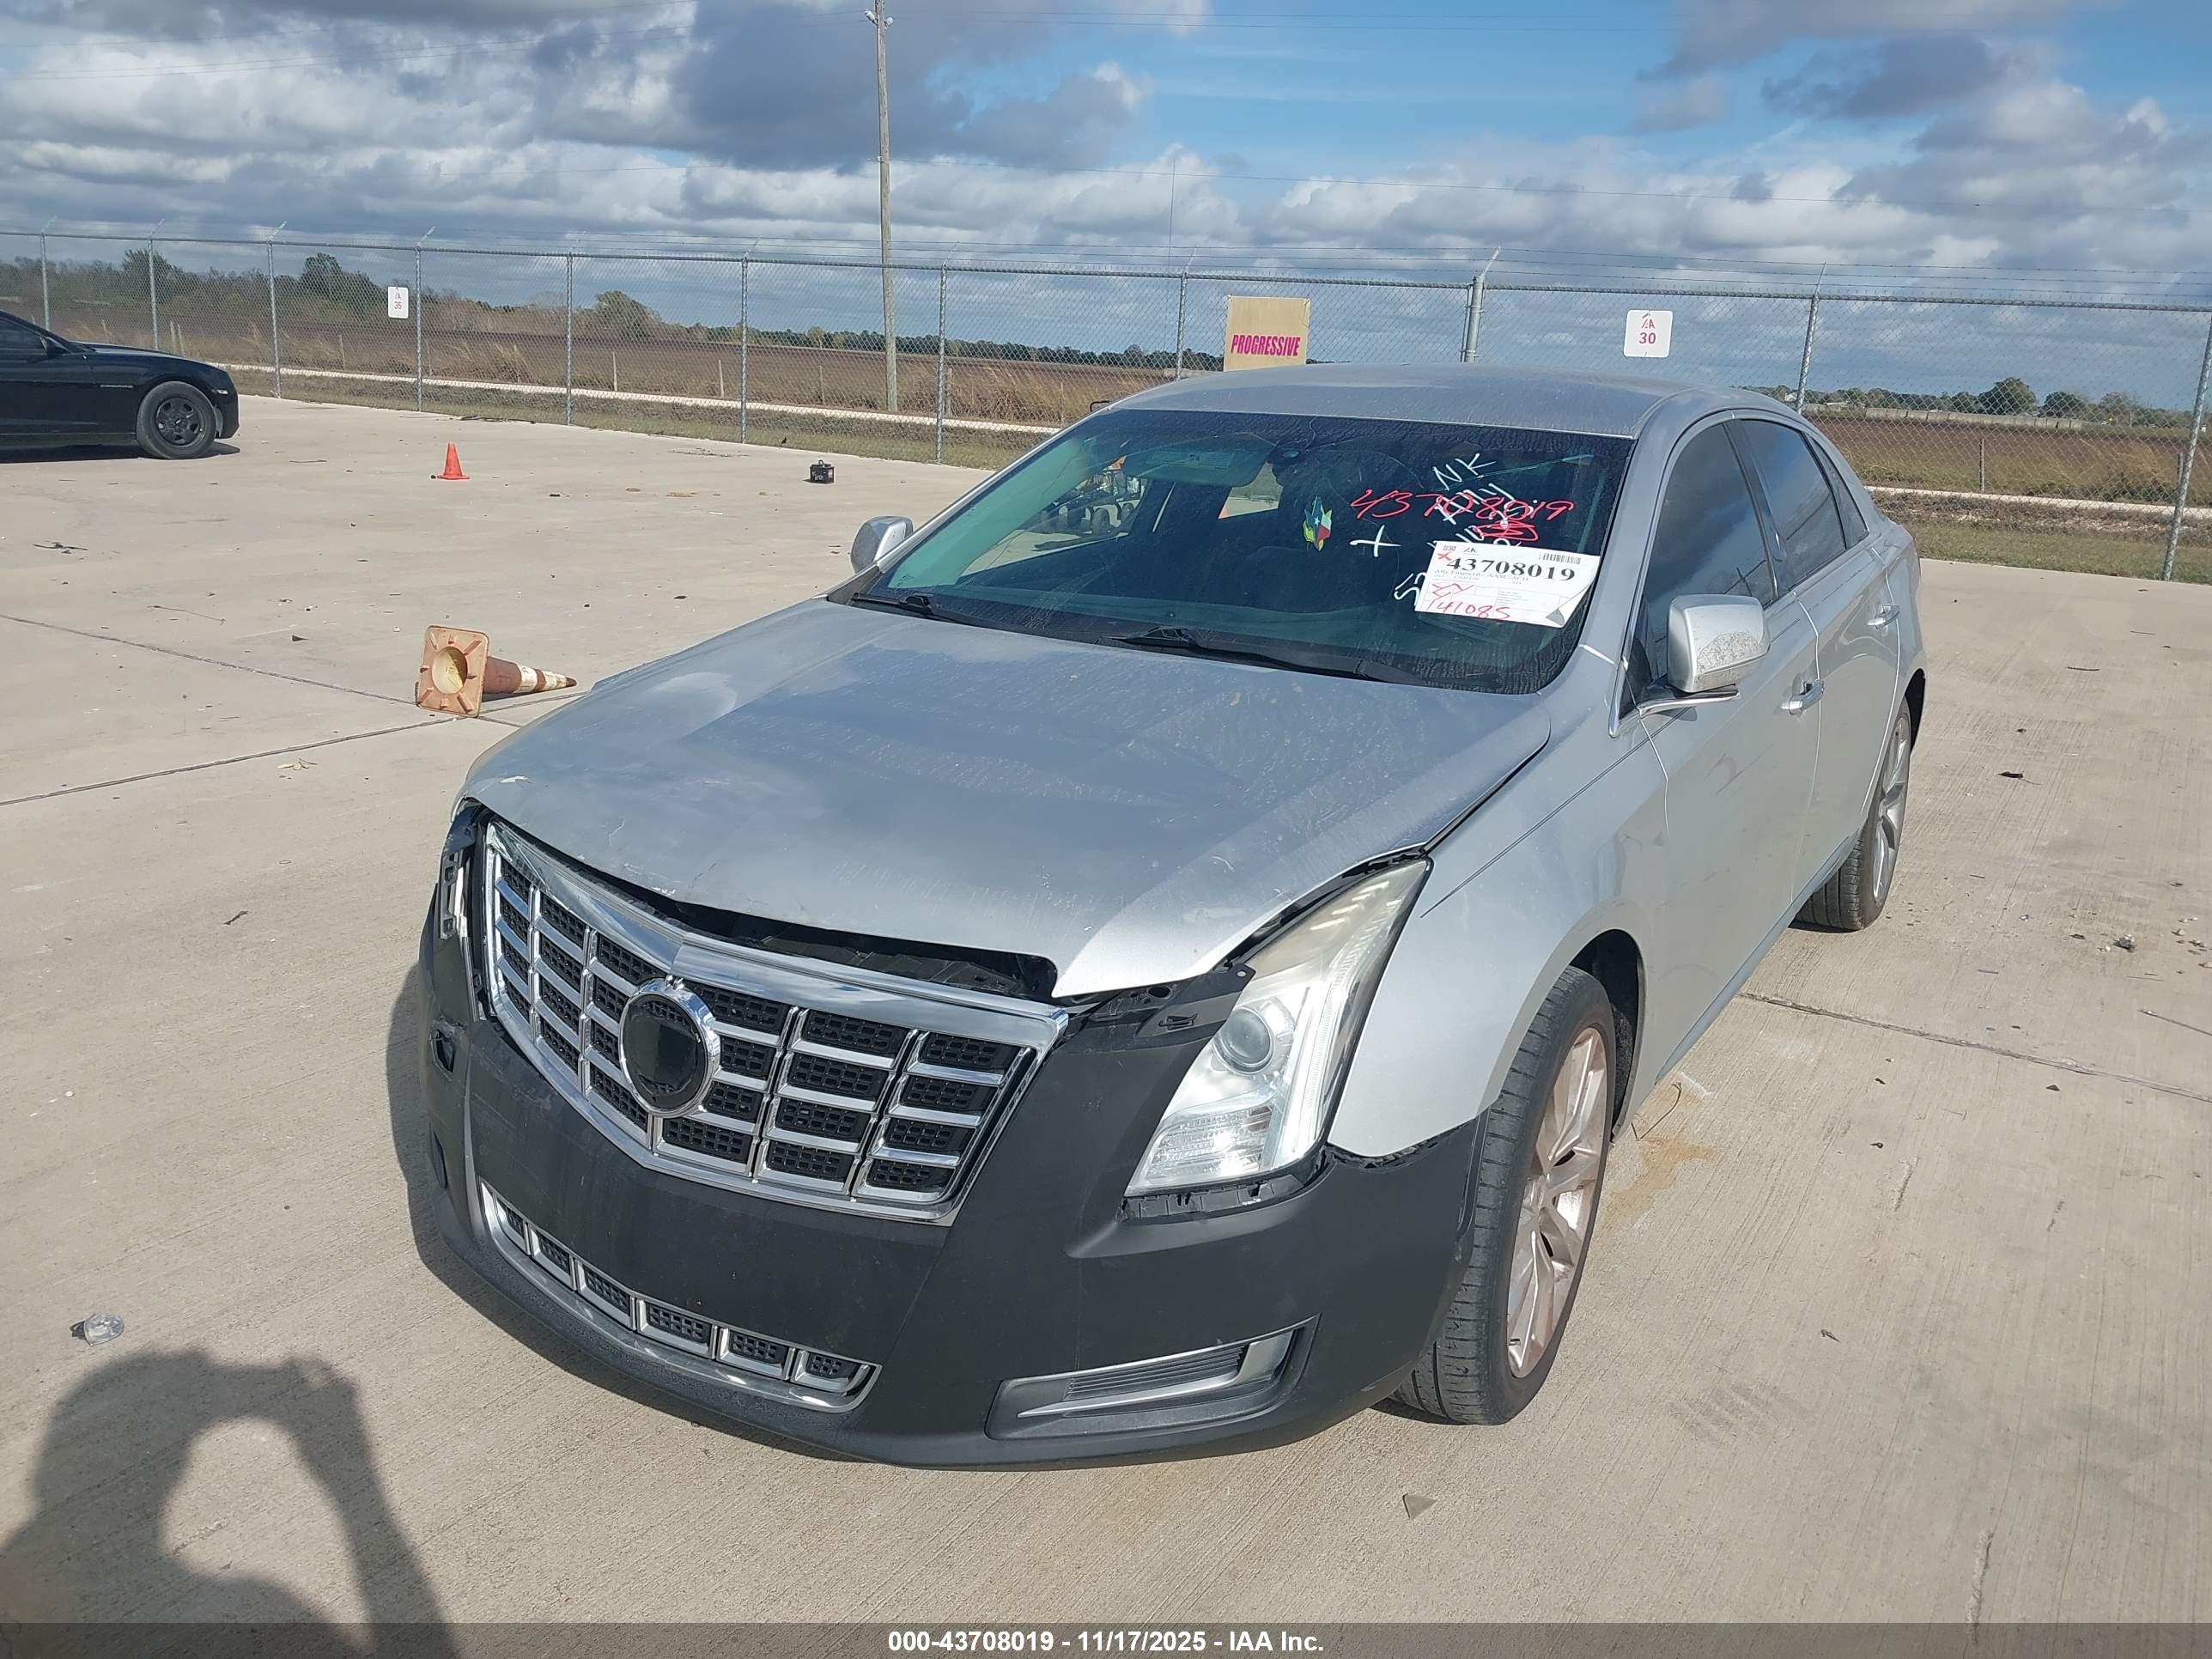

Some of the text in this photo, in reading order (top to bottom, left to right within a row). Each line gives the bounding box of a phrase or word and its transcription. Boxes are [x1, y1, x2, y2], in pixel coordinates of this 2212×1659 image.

[394, 301, 402, 309] 35
[1231, 334, 1301, 356] PROGRESSIVE
[1638, 331, 1656, 344] 30
[1350, 489, 1575, 521] 43708019
[1446, 557, 1575, 581] 43708019
